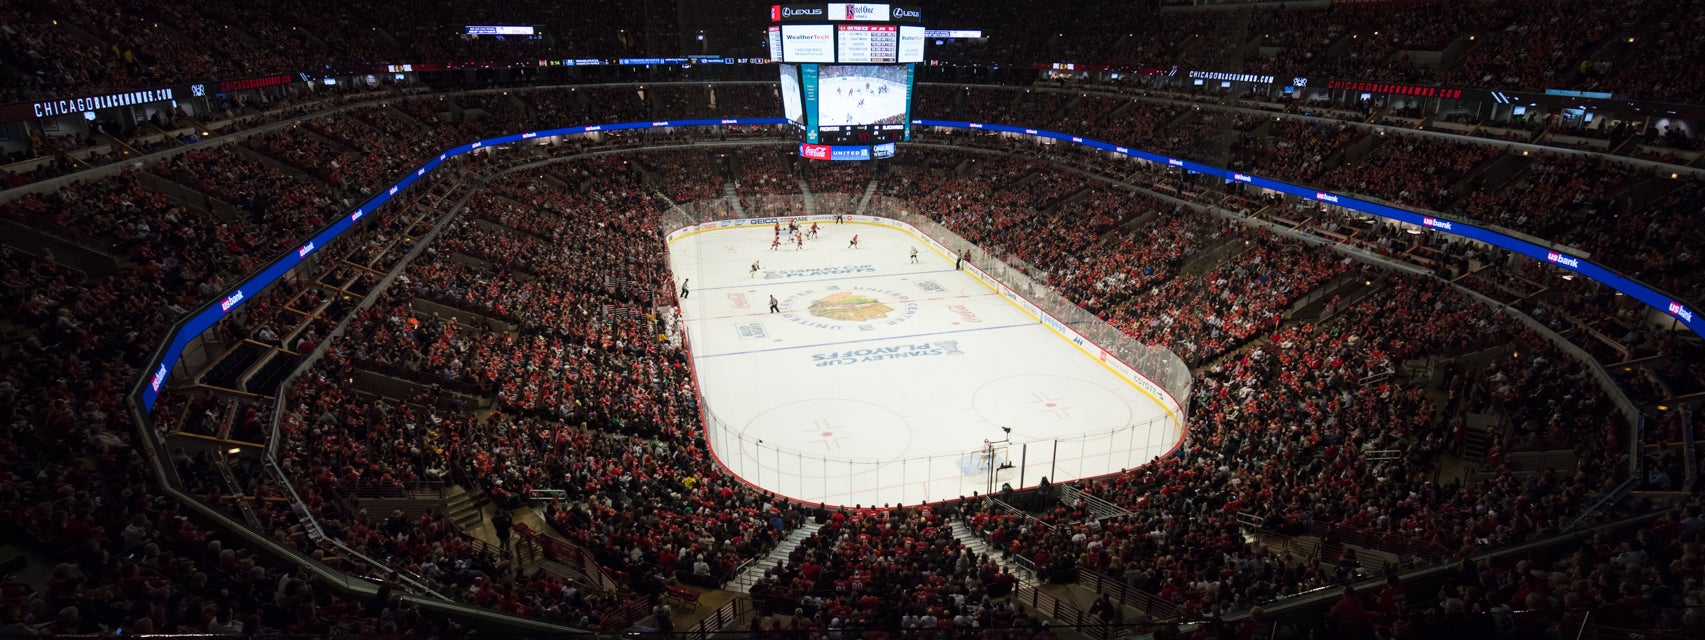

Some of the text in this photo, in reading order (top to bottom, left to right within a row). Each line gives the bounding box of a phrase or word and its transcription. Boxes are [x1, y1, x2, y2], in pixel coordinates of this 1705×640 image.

[1189, 70, 1274, 84] CHICAGOBLACKHAWKS.COM
[1328, 79, 1462, 99] CHICAGOBLACKHAWKS.COM
[34, 88, 173, 118] CHICAGOBLACKHAWKS.COM
[812, 342, 932, 362] PLAYOFFS
[816, 348, 943, 367] STANLEY CUP
